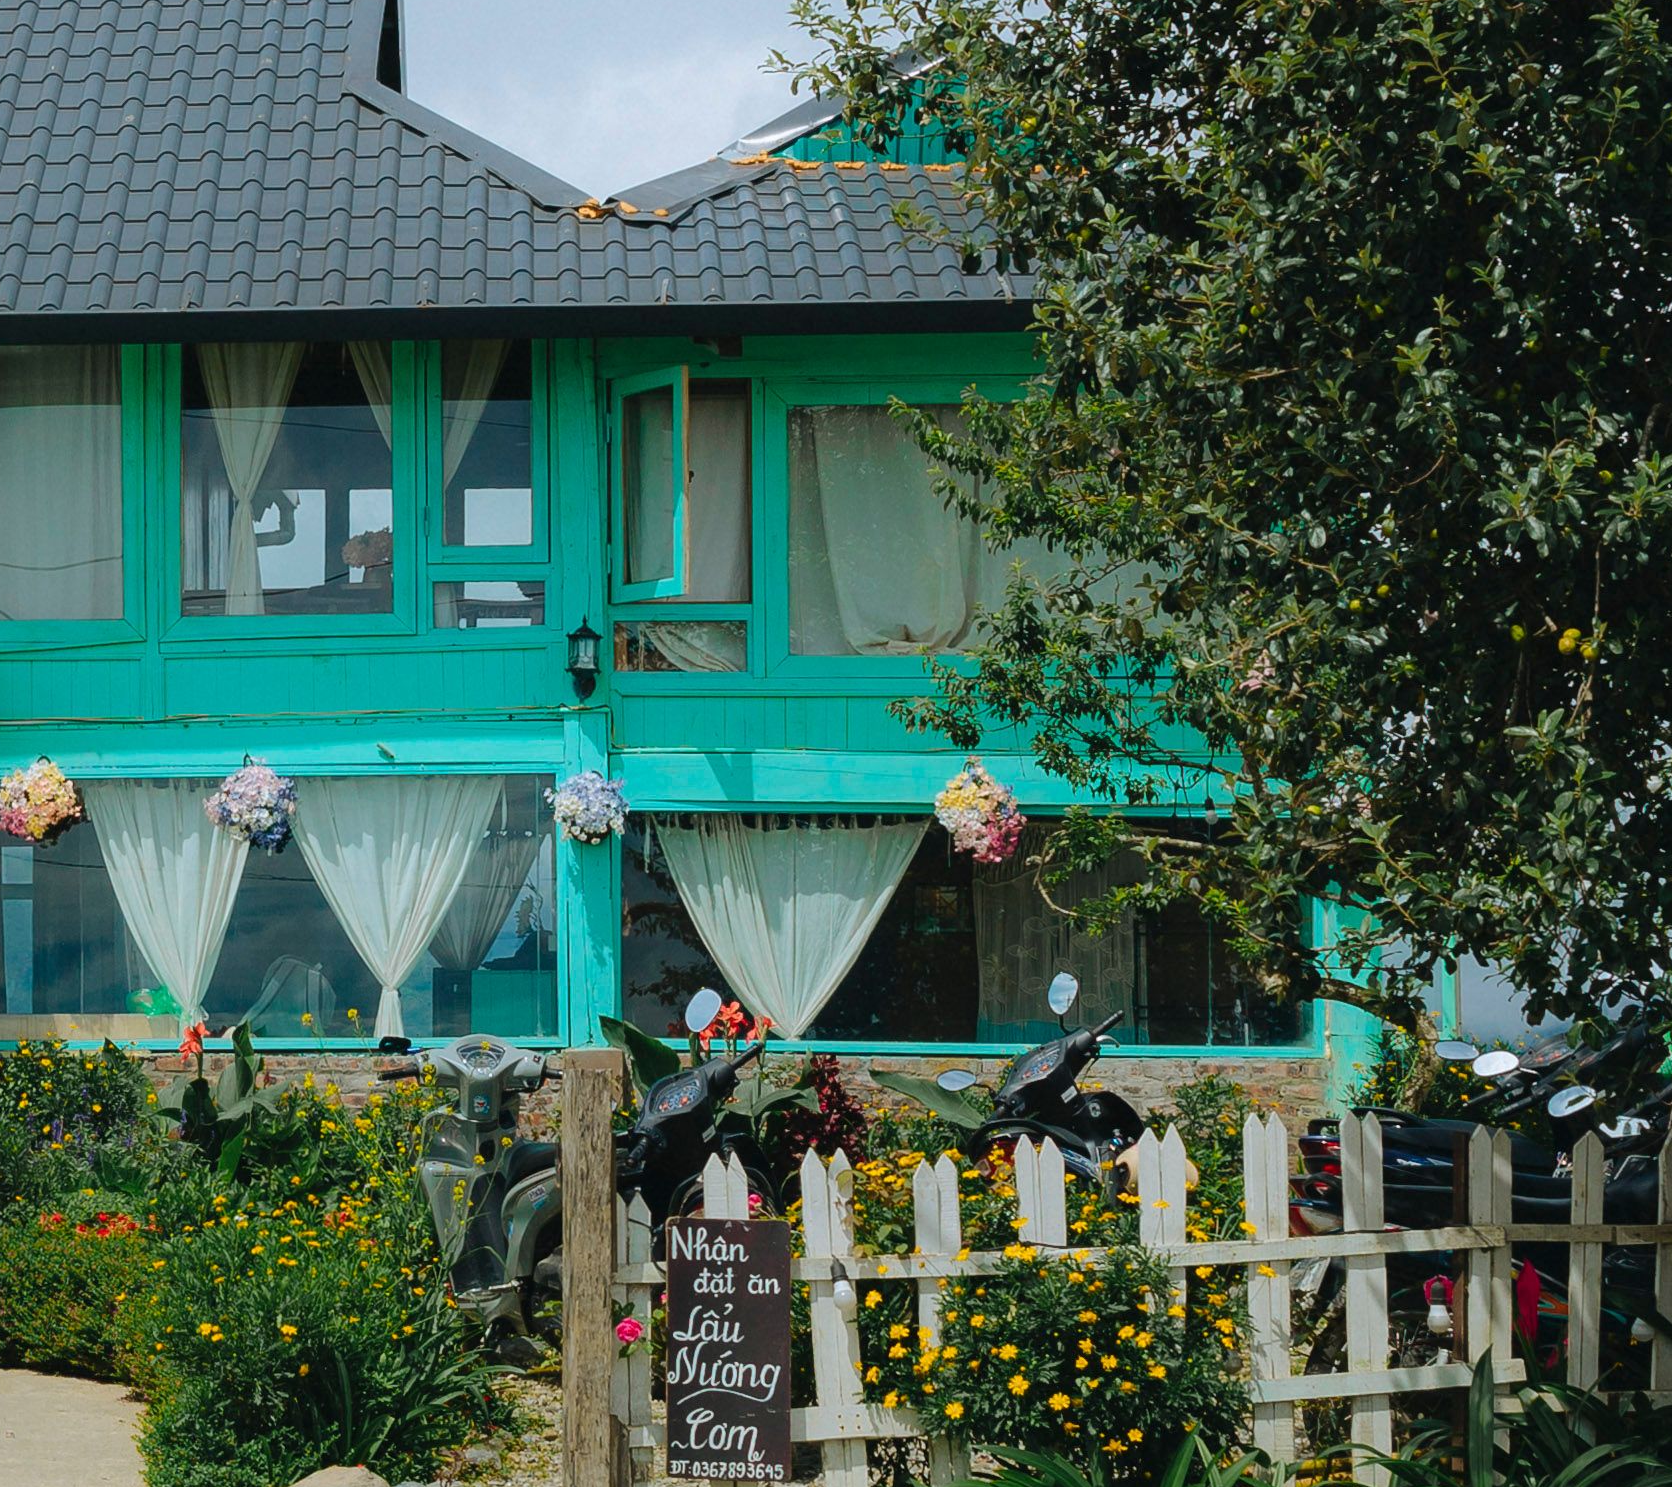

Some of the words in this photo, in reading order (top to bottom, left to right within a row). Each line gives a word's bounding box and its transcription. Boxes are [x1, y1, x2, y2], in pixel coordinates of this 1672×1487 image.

[671, 1225, 750, 1265] Nhận
[693, 1267, 736, 1298] đặt
[747, 1274, 781, 1294] ăn
[672, 1303, 745, 1343] Lẩu
[667, 1341, 782, 1403] Nướng
[686, 1407, 766, 1463] Cơm
